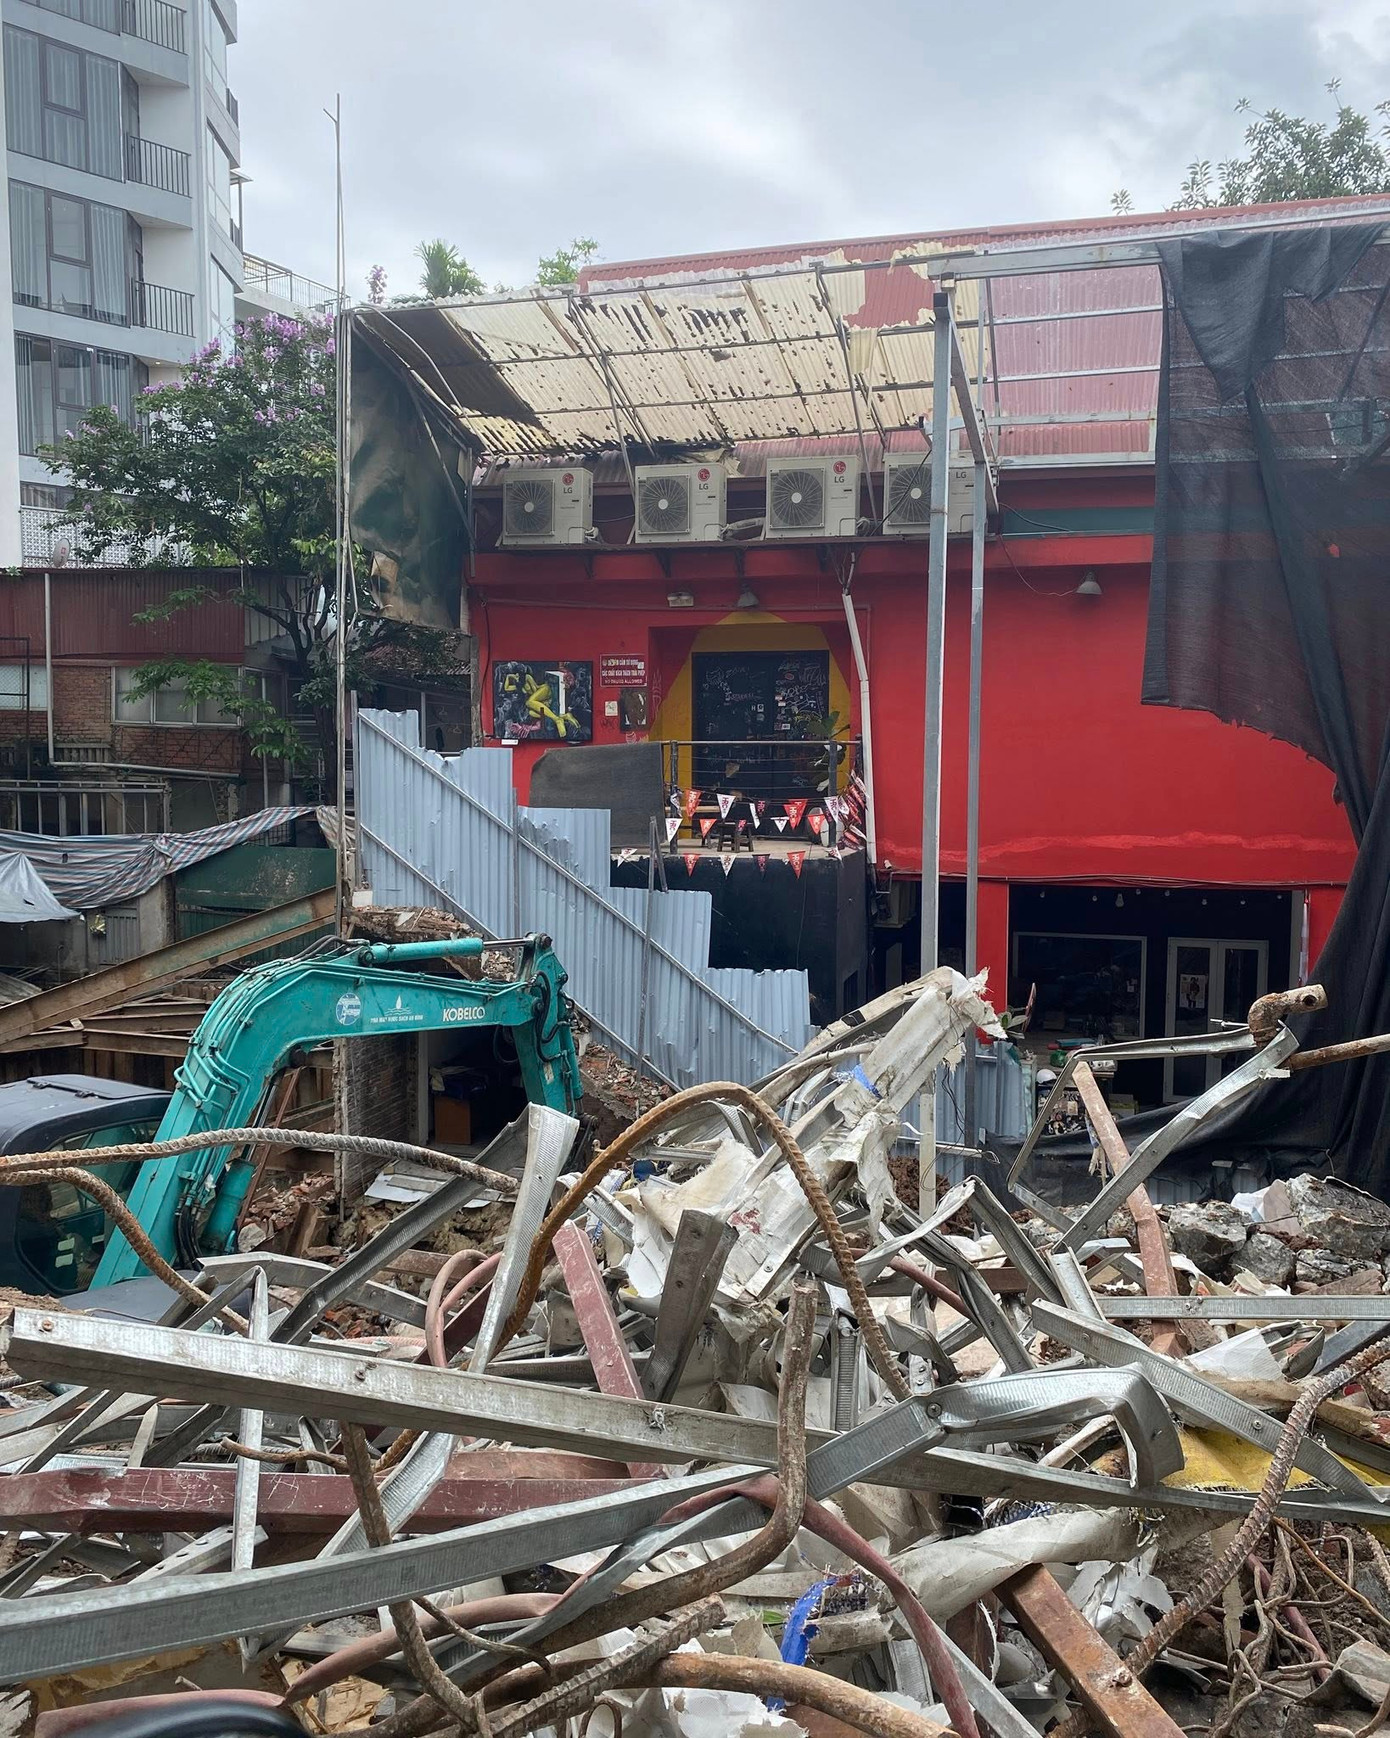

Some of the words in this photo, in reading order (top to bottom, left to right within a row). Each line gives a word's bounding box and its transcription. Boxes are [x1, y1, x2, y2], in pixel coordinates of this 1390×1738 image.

[956, 471, 967, 479] LG
[721, 797, 729, 809] HRC
[830, 799, 839, 811] HRC
[789, 806, 797, 818] HRC
[792, 854, 801, 866] HRC
[442, 1006, 486, 1022] KOBELCO
